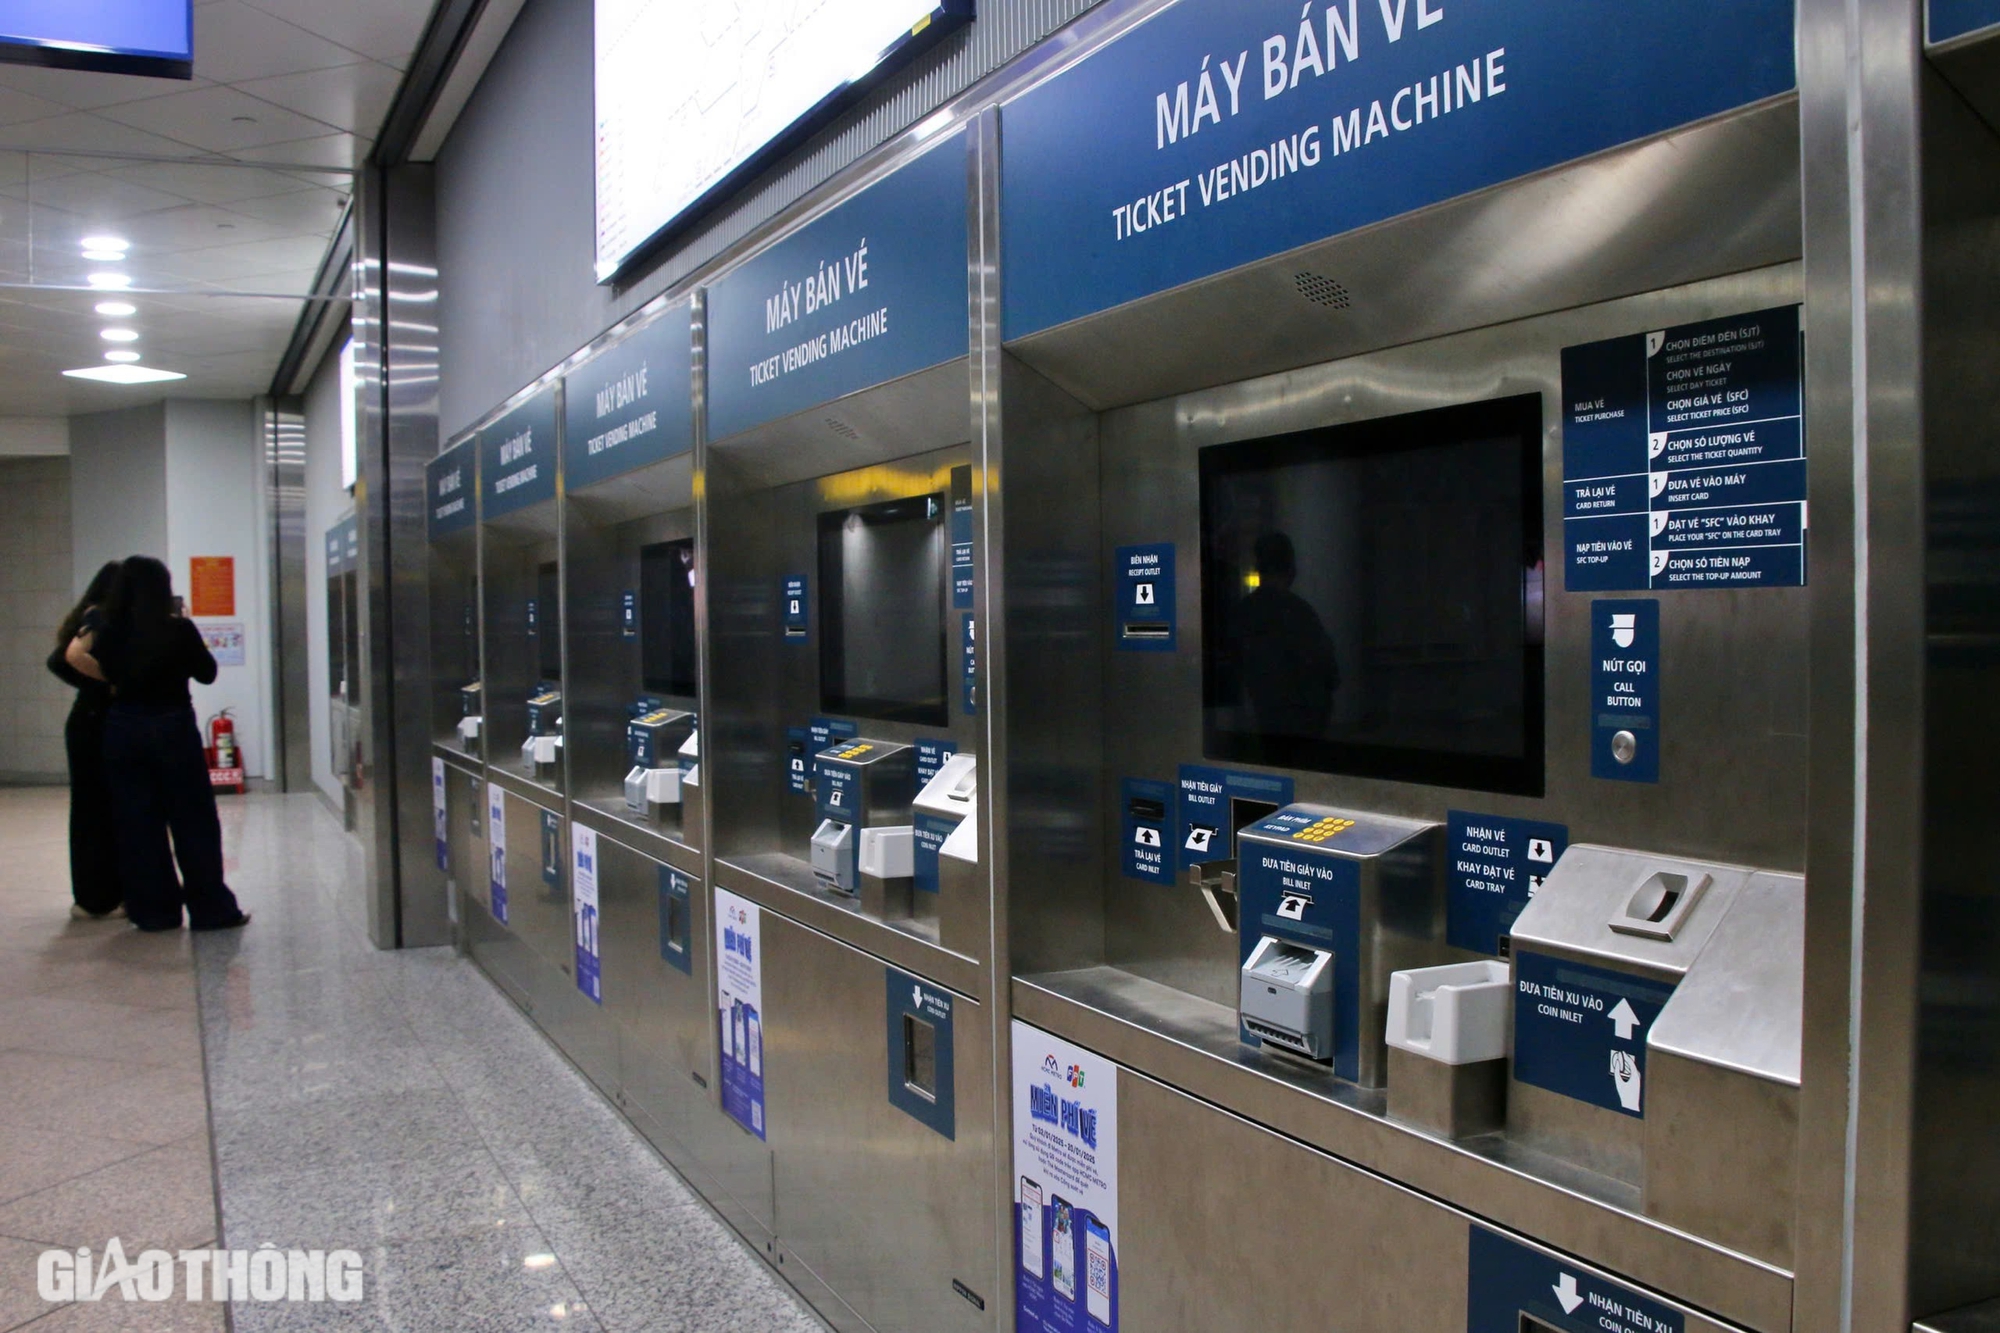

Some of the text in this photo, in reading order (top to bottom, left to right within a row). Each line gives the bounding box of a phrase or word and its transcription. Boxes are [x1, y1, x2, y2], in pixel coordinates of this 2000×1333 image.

[1156, 50, 1248, 150] MÁY
[1263, 0, 1358, 100] BÁN
[1112, 48, 1506, 240] TICKET VENDING MACHINE
[766, 237, 868, 334] MÁY BÁN VÉ
[750, 307, 888, 387] TICKET VENDING MACHINE
[1666, 338, 1690, 353] CHỌN
[1739, 324, 1760, 341] (SJT)
[1666, 353, 1687, 364] SELECT
[1689, 351, 1701, 361] THE
[1667, 367, 1691, 383] CHỌN
[1666, 377, 1727, 394] SELECT DAY TICKET
[1574, 397, 1605, 412] MUA VÉ
[1667, 388, 1749, 413] CHỌN GIÁ VÉ (SFC)
[1575, 410, 1625, 424] TICKET PURCHASE
[1667, 404, 1749, 423] SELECT TICKET PRICE (SFC)
[1653, 439, 1659, 450] 2
[1667, 430, 1756, 454] CHỌN SỐ LƯỢNG VÉ
[1667, 446, 1763, 464] SELECT THE TICKET QUANTITY
[1653, 479, 1659, 490] 1
[1668, 473, 1747, 491] ĐƯA VÉ VÀO MÁY
[1575, 483, 1616, 500] TRẢ LẠI VÉ
[1668, 491, 1709, 503] INSERT CARD
[1575, 499, 1616, 511] CARD RETURN
[1653, 518, 1659, 529] 1
[1668, 519, 1688, 533] ĐẠT
[1689, 517, 1700, 529] VÉ
[1726, 513, 1748, 526] VÀO
[1749, 513, 1776, 526] KHAY
[1668, 533, 1687, 542] PLACE
[1688, 532, 1704, 542] YOUR
[1722, 530, 1732, 540] ON
[1733, 530, 1744, 539] THE
[1745, 528, 1764, 538] CARD
[1764, 528, 1782, 538] TRAY
[1575, 543, 1591, 555] NẠP
[1607, 540, 1623, 552] VÀO
[1576, 555, 1609, 565] SFC TOP-UP
[1654, 557, 1660, 568] 2
[1669, 554, 1751, 572] CHỌN SỐ TIỀN NẠP
[1669, 570, 1761, 582] SELECT THE TOP-UP AMOUNT
[1603, 657, 1646, 676] NÚT GỌI
[1613, 682, 1635, 693] CALL
[1607, 696, 1642, 708] BUTTON
[1181, 779, 1196, 792] NHẬN
[1188, 794, 1216, 805] BILL OUTLET
[1466, 826, 1506, 843] NHẬN VÉ
[1462, 842, 1510, 858] CARD OUTLET
[1262, 857, 1333, 881] ĐƯA TIỀN GIẤY VÀO
[1457, 860, 1515, 881] KHAY ĐẠT VÉ
[1282, 876, 1311, 891] BILL INLET
[1465, 878, 1506, 894] CARD TRAY
[1520, 980, 1604, 1012] ĐƯA TIỀN XU VÀO
[1537, 1003, 1583, 1024] COIN INLET
[1588, 1291, 1622, 1317] NHẬN
[1624, 1306, 1652, 1330] TIỀN
[1599, 1316, 1622, 1333] COIN
